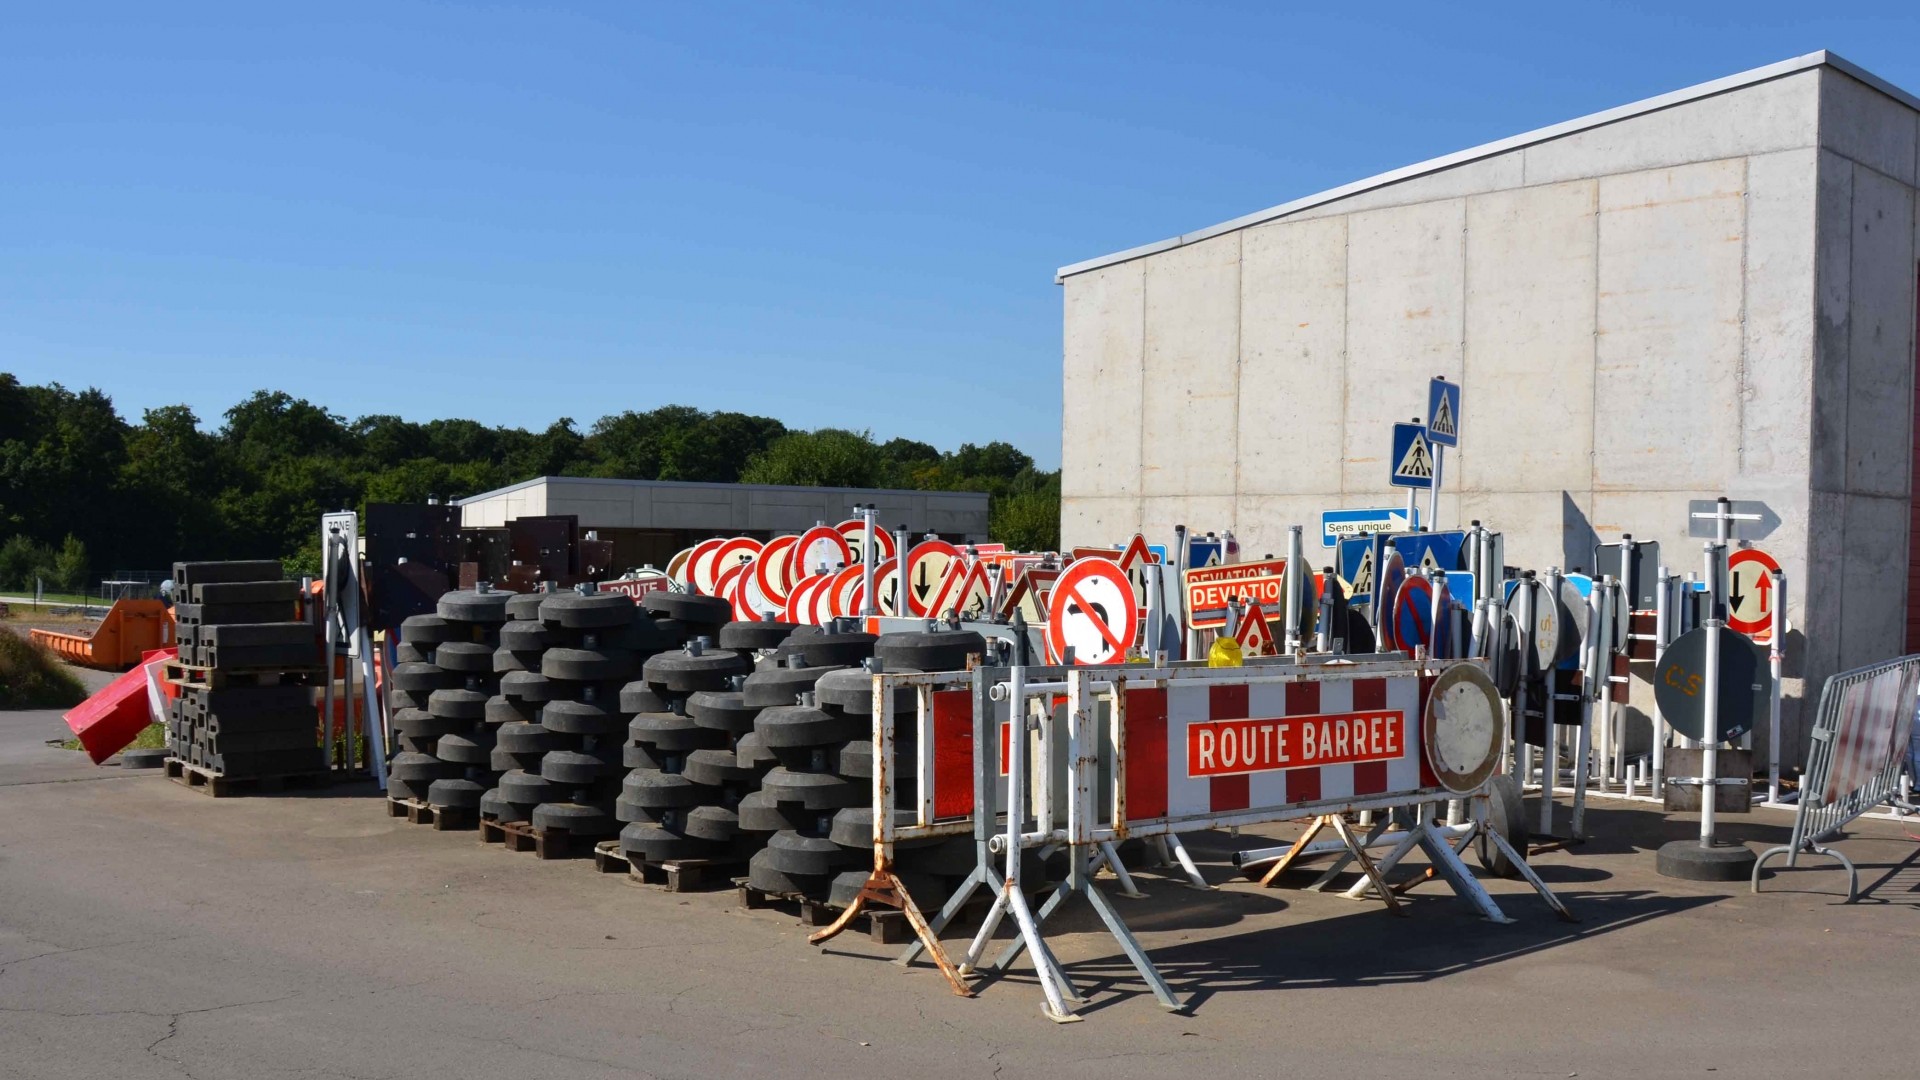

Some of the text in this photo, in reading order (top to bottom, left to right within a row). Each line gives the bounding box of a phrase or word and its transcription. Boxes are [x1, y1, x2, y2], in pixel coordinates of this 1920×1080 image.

[1328, 522, 1392, 533] Sens unique
[1199, 716, 1398, 770] ROUTE BARREE
